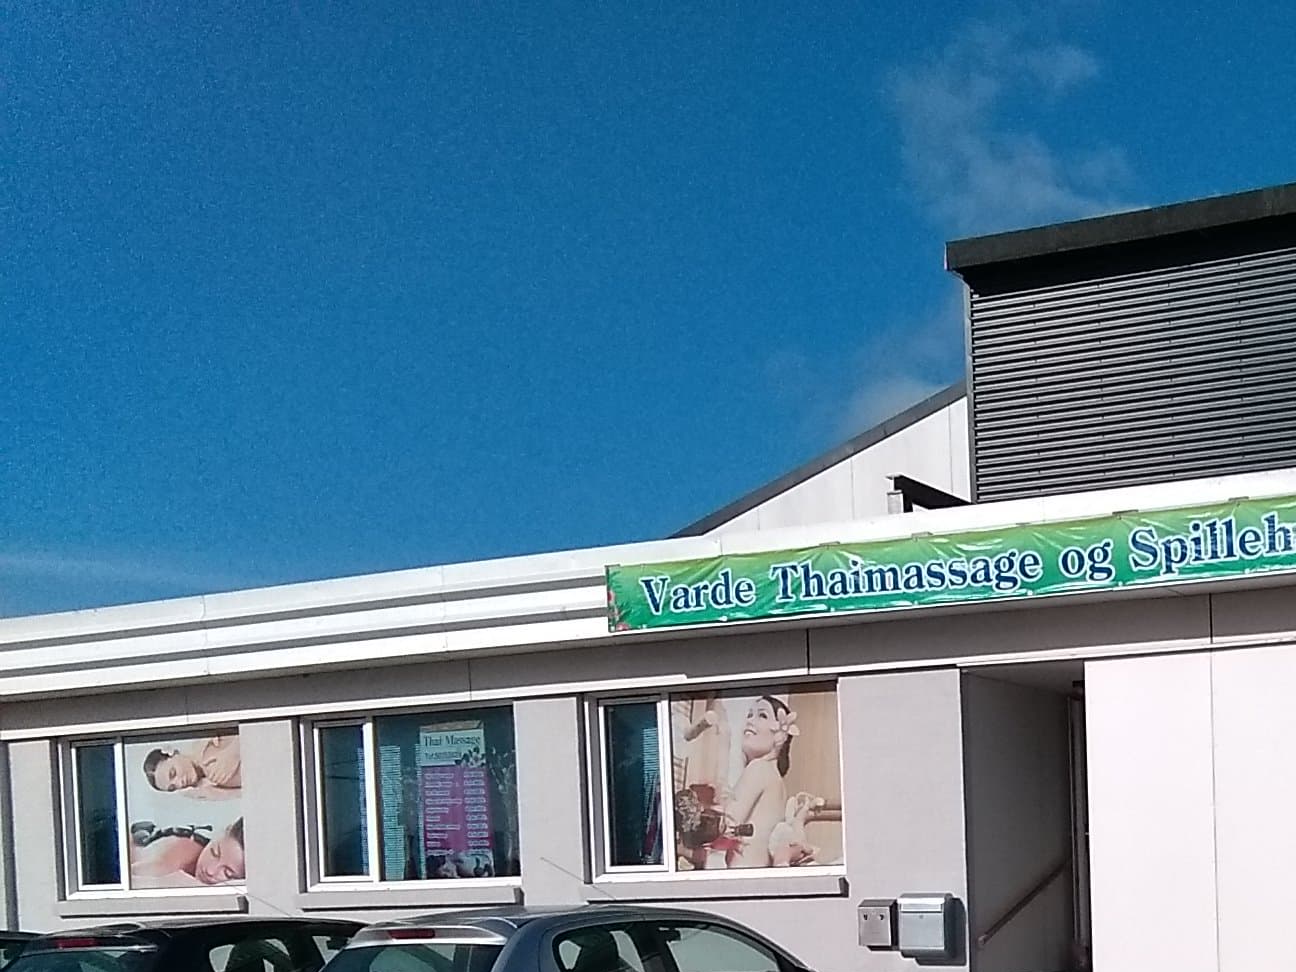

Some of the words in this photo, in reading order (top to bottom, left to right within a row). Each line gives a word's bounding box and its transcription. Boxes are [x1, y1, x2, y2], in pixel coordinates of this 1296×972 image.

[642, 570, 754, 614] Varde
[771, 552, 1042, 602] Thaimassage
[1060, 541, 1113, 579] og
[423, 734, 442, 747] Thai
